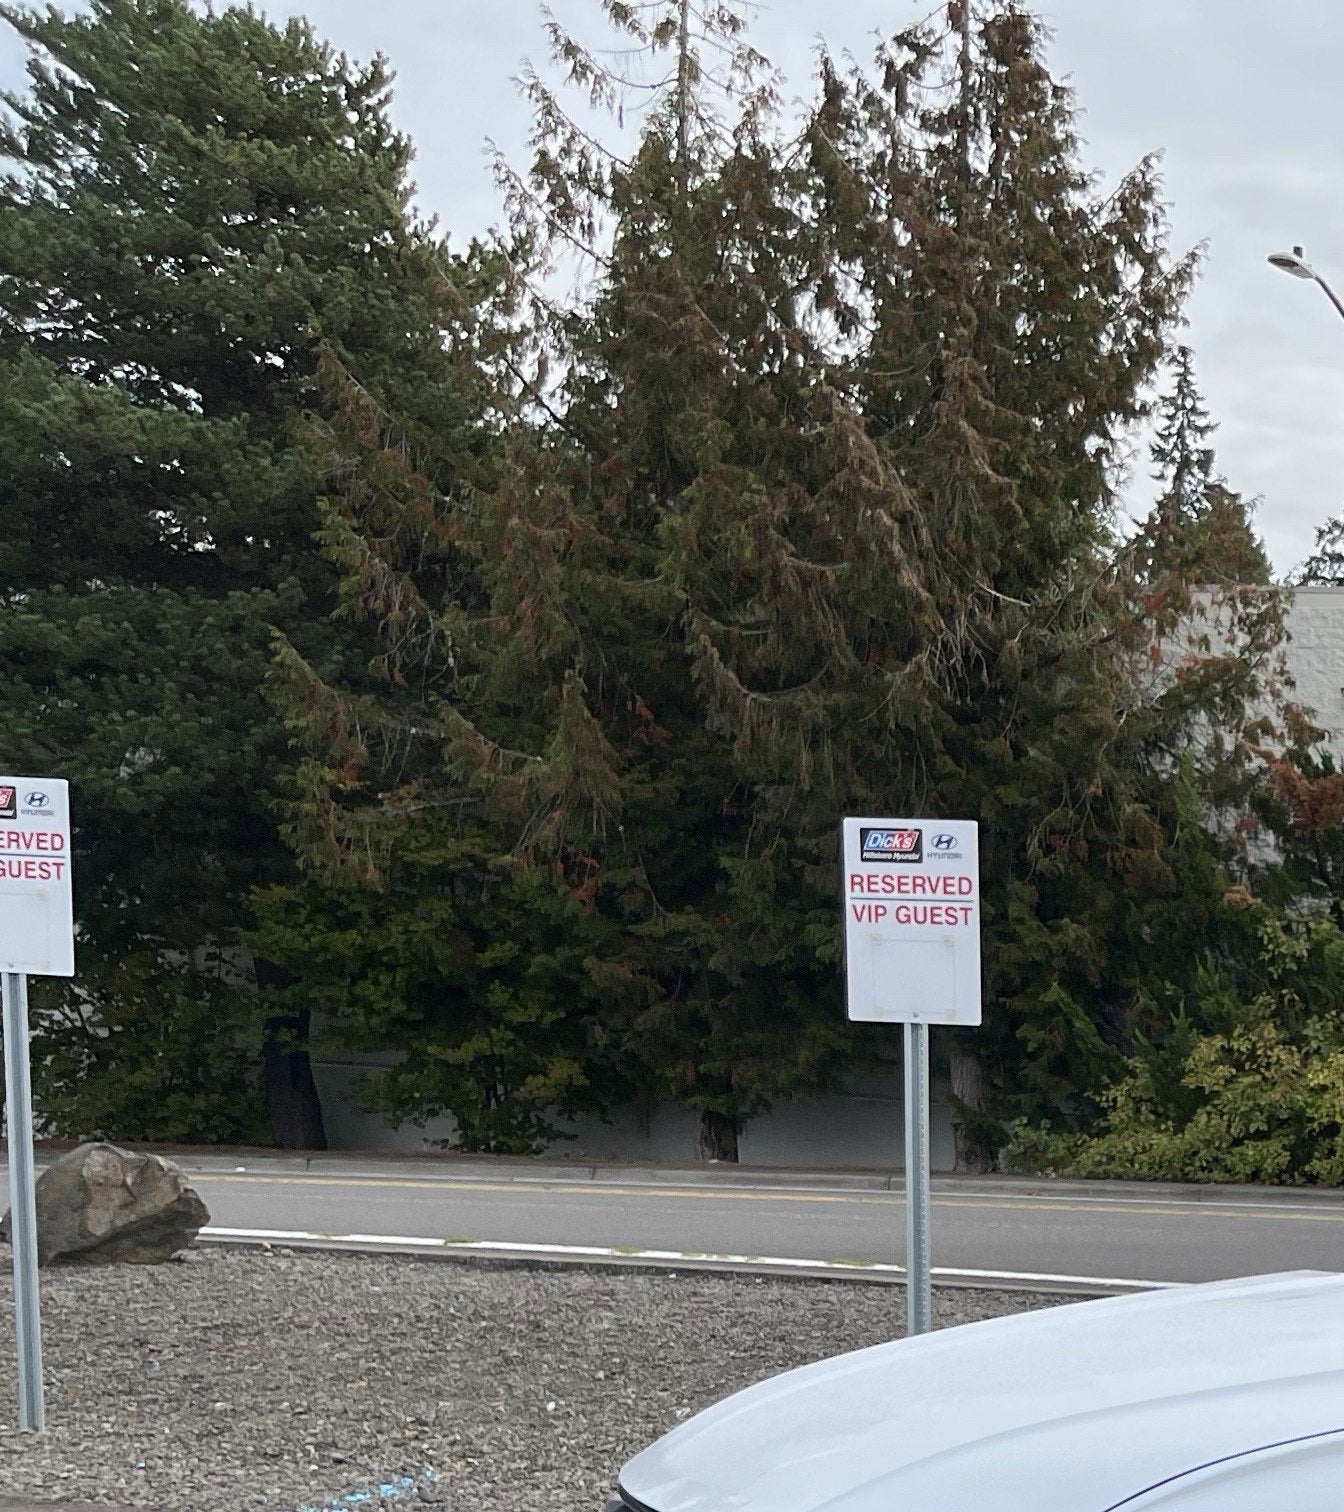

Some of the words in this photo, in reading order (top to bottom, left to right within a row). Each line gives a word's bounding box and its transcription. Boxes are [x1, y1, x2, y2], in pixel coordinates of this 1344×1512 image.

[850, 873, 973, 896] RESERVED
[852, 903, 888, 924] VIP
[895, 905, 973, 926] GUEST
